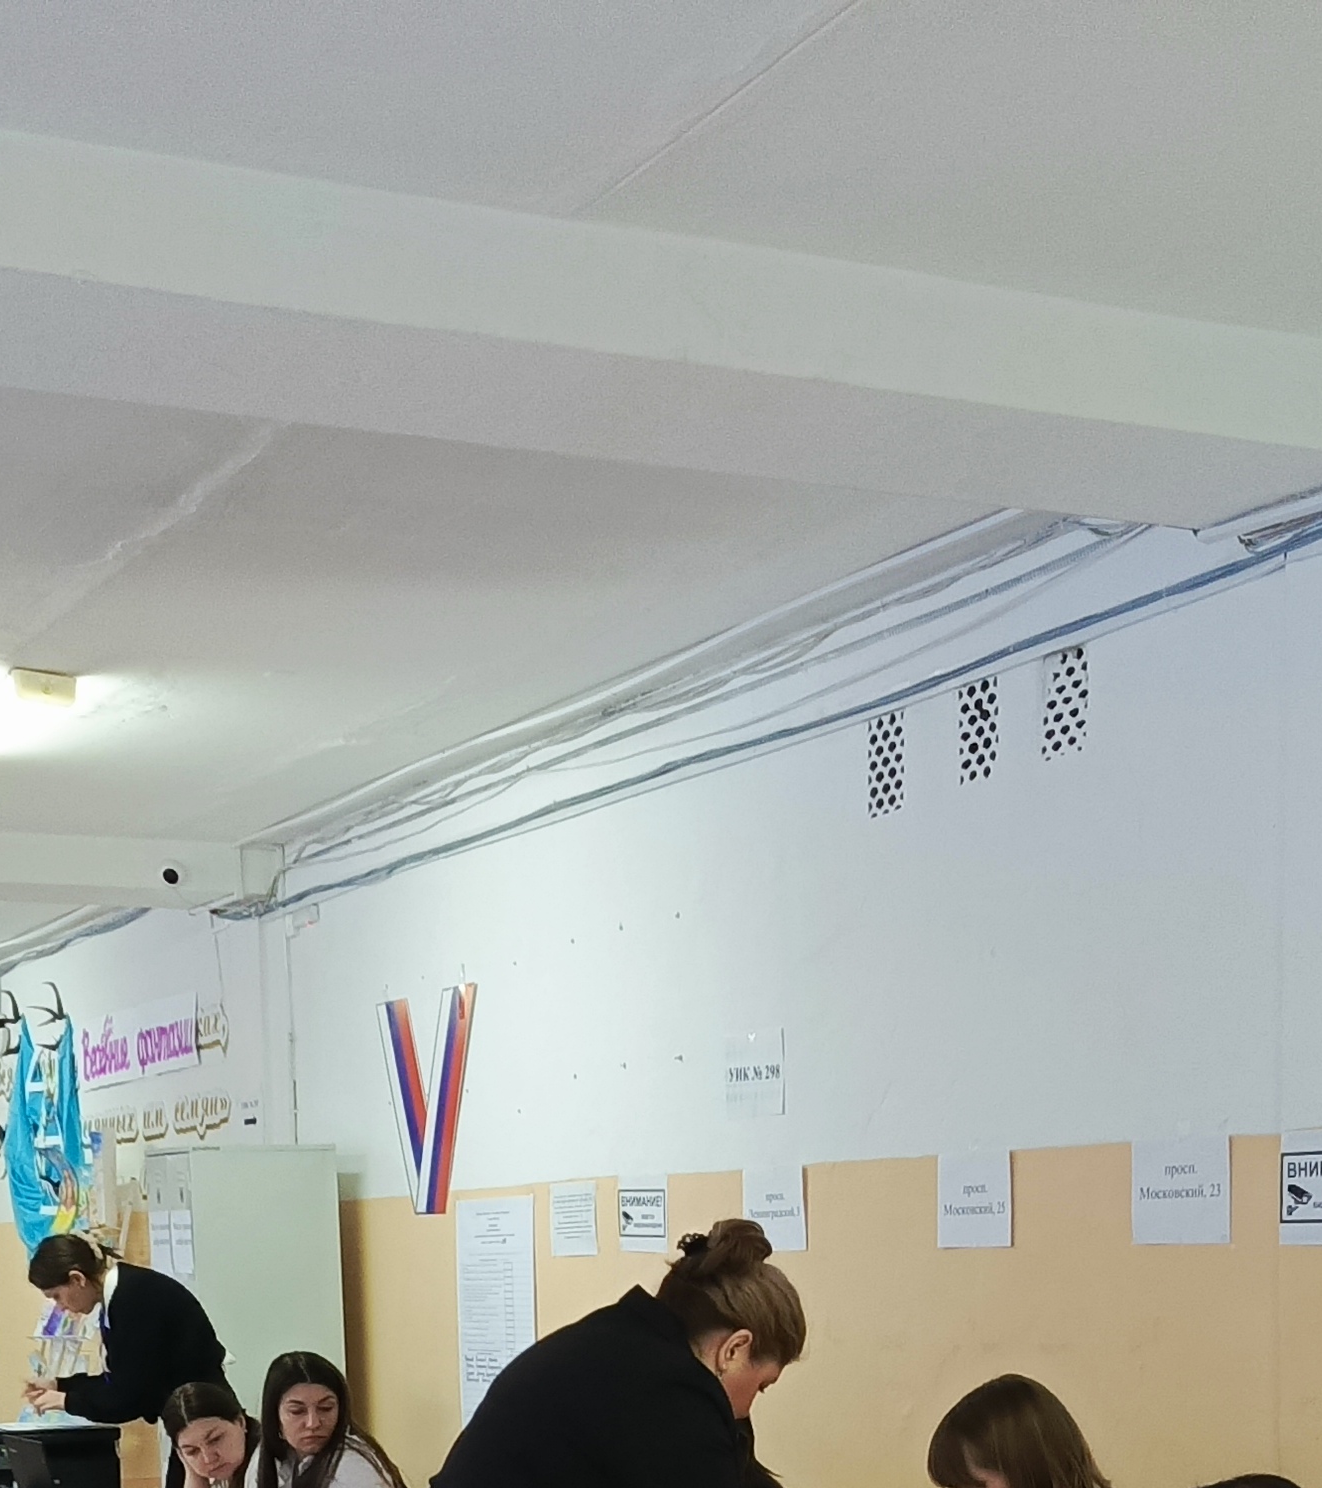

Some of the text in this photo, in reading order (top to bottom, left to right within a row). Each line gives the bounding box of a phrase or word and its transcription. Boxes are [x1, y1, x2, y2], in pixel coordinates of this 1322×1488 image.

[728, 1065, 750, 1082] УИК
[765, 1064, 780, 1080] 298
[1164, 1163, 1198, 1178] просп.
[1139, 1183, 1221, 1201] Московский, 23
